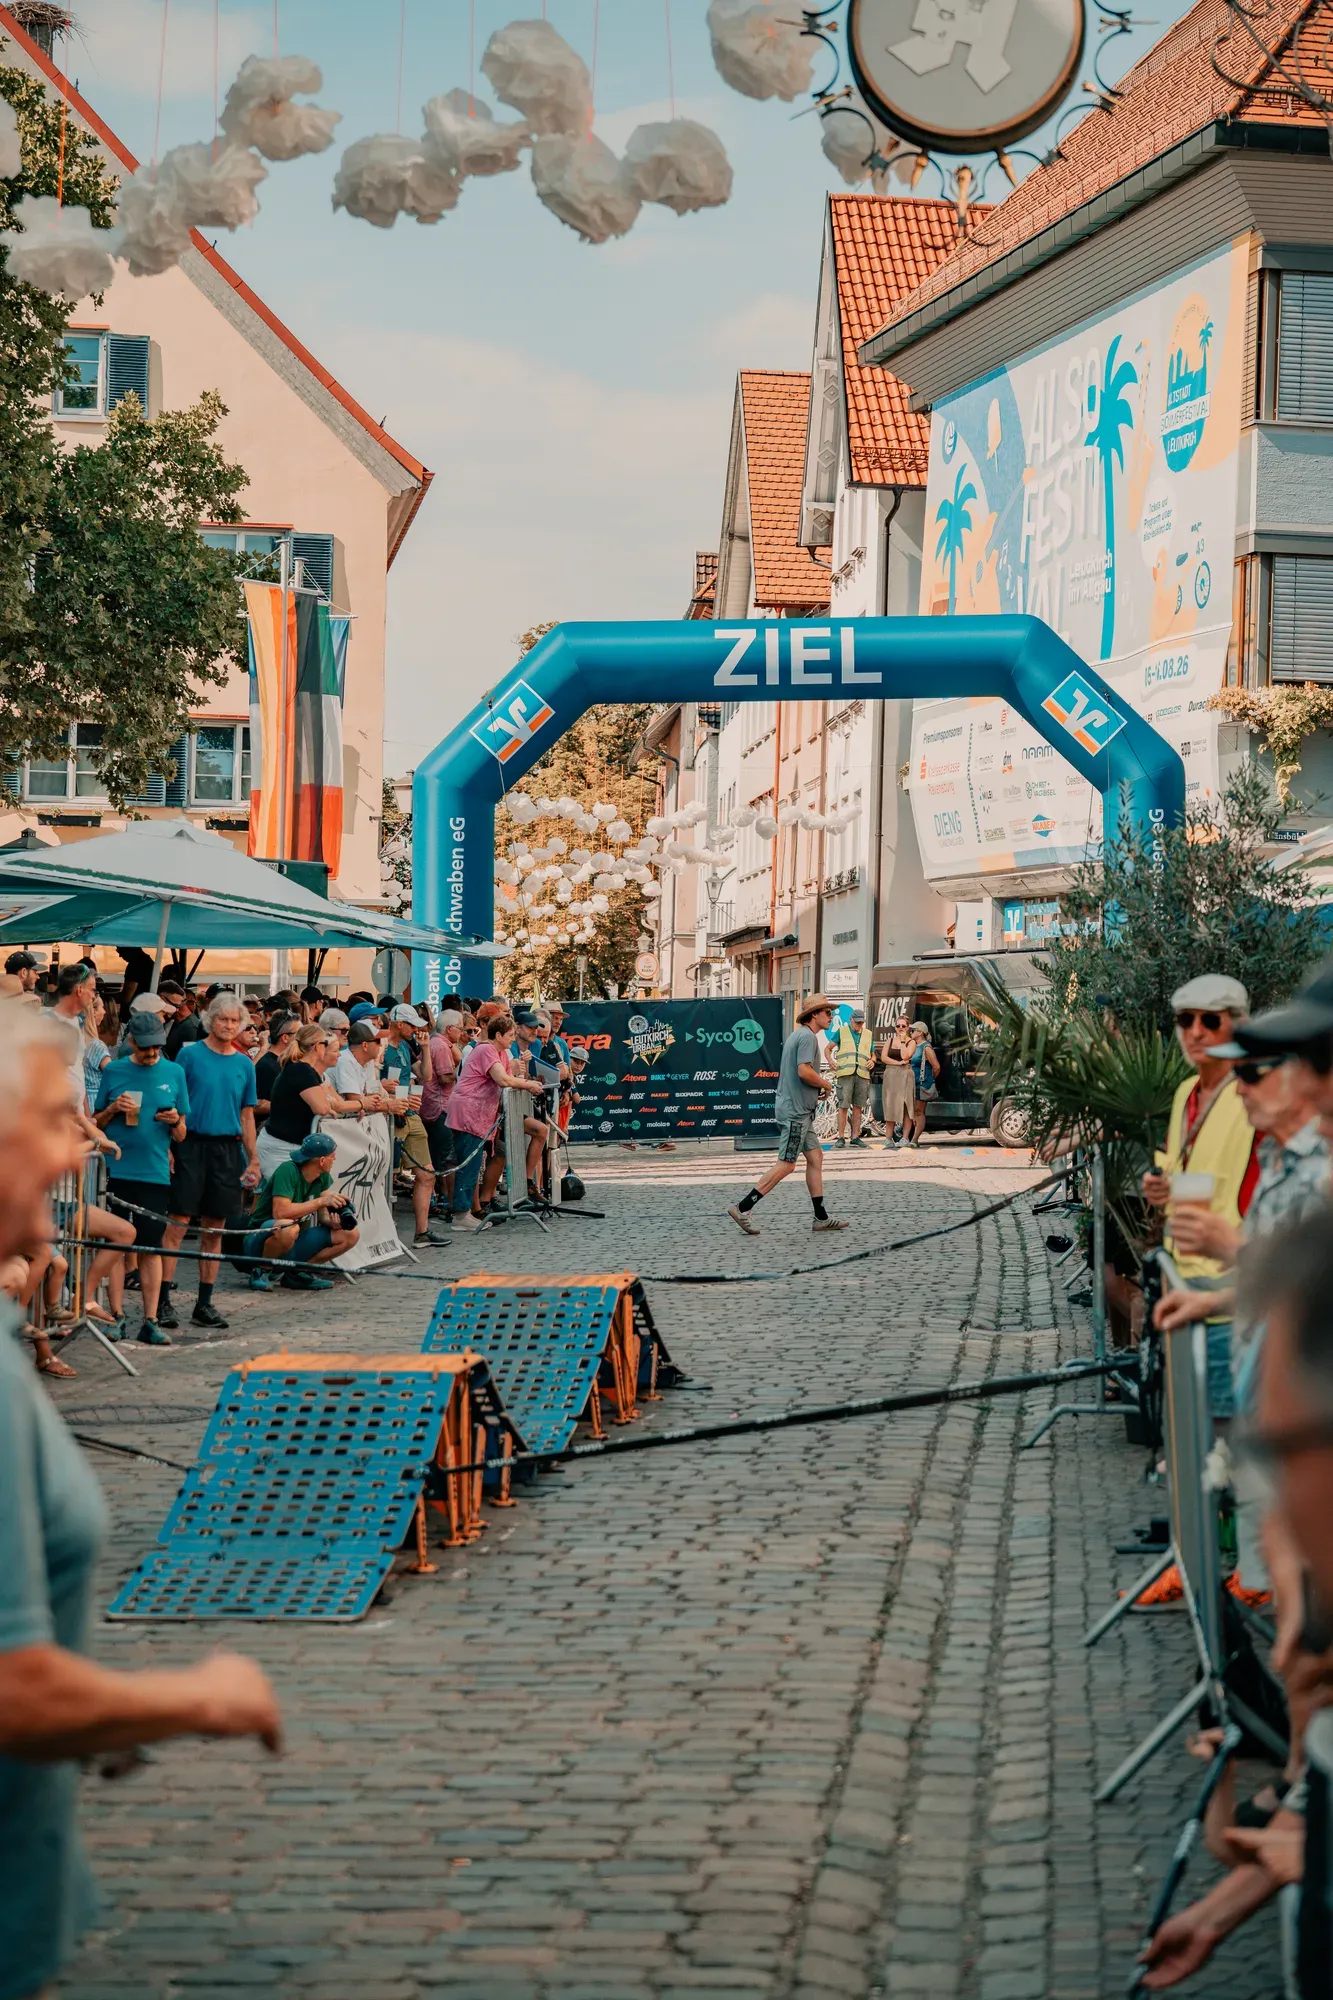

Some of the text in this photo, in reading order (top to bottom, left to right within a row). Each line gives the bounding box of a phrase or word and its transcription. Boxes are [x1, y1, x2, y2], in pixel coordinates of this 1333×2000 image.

[1026, 346, 1101, 465] ALSO
[1167, 383, 1192, 406] ALTSTADT
[1167, 430, 1197, 455] LEUTKIRCH
[1019, 445, 1103, 564] FESTI
[714, 627, 882, 686] ZIEL
[450, 817, 466, 842] eG
[933, 810, 963, 838] DIENG
[875, 997, 910, 1028] ROSE
[630, 1030, 669, 1046] LEUTKIRCH
[632, 1043, 655, 1053] URBAN
[696, 1024, 763, 1049] SycoTec
[593, 1073, 617, 1084] SycoTec
[693, 1071, 718, 1081] ROSE
[726, 1070, 749, 1080] SycoTec
